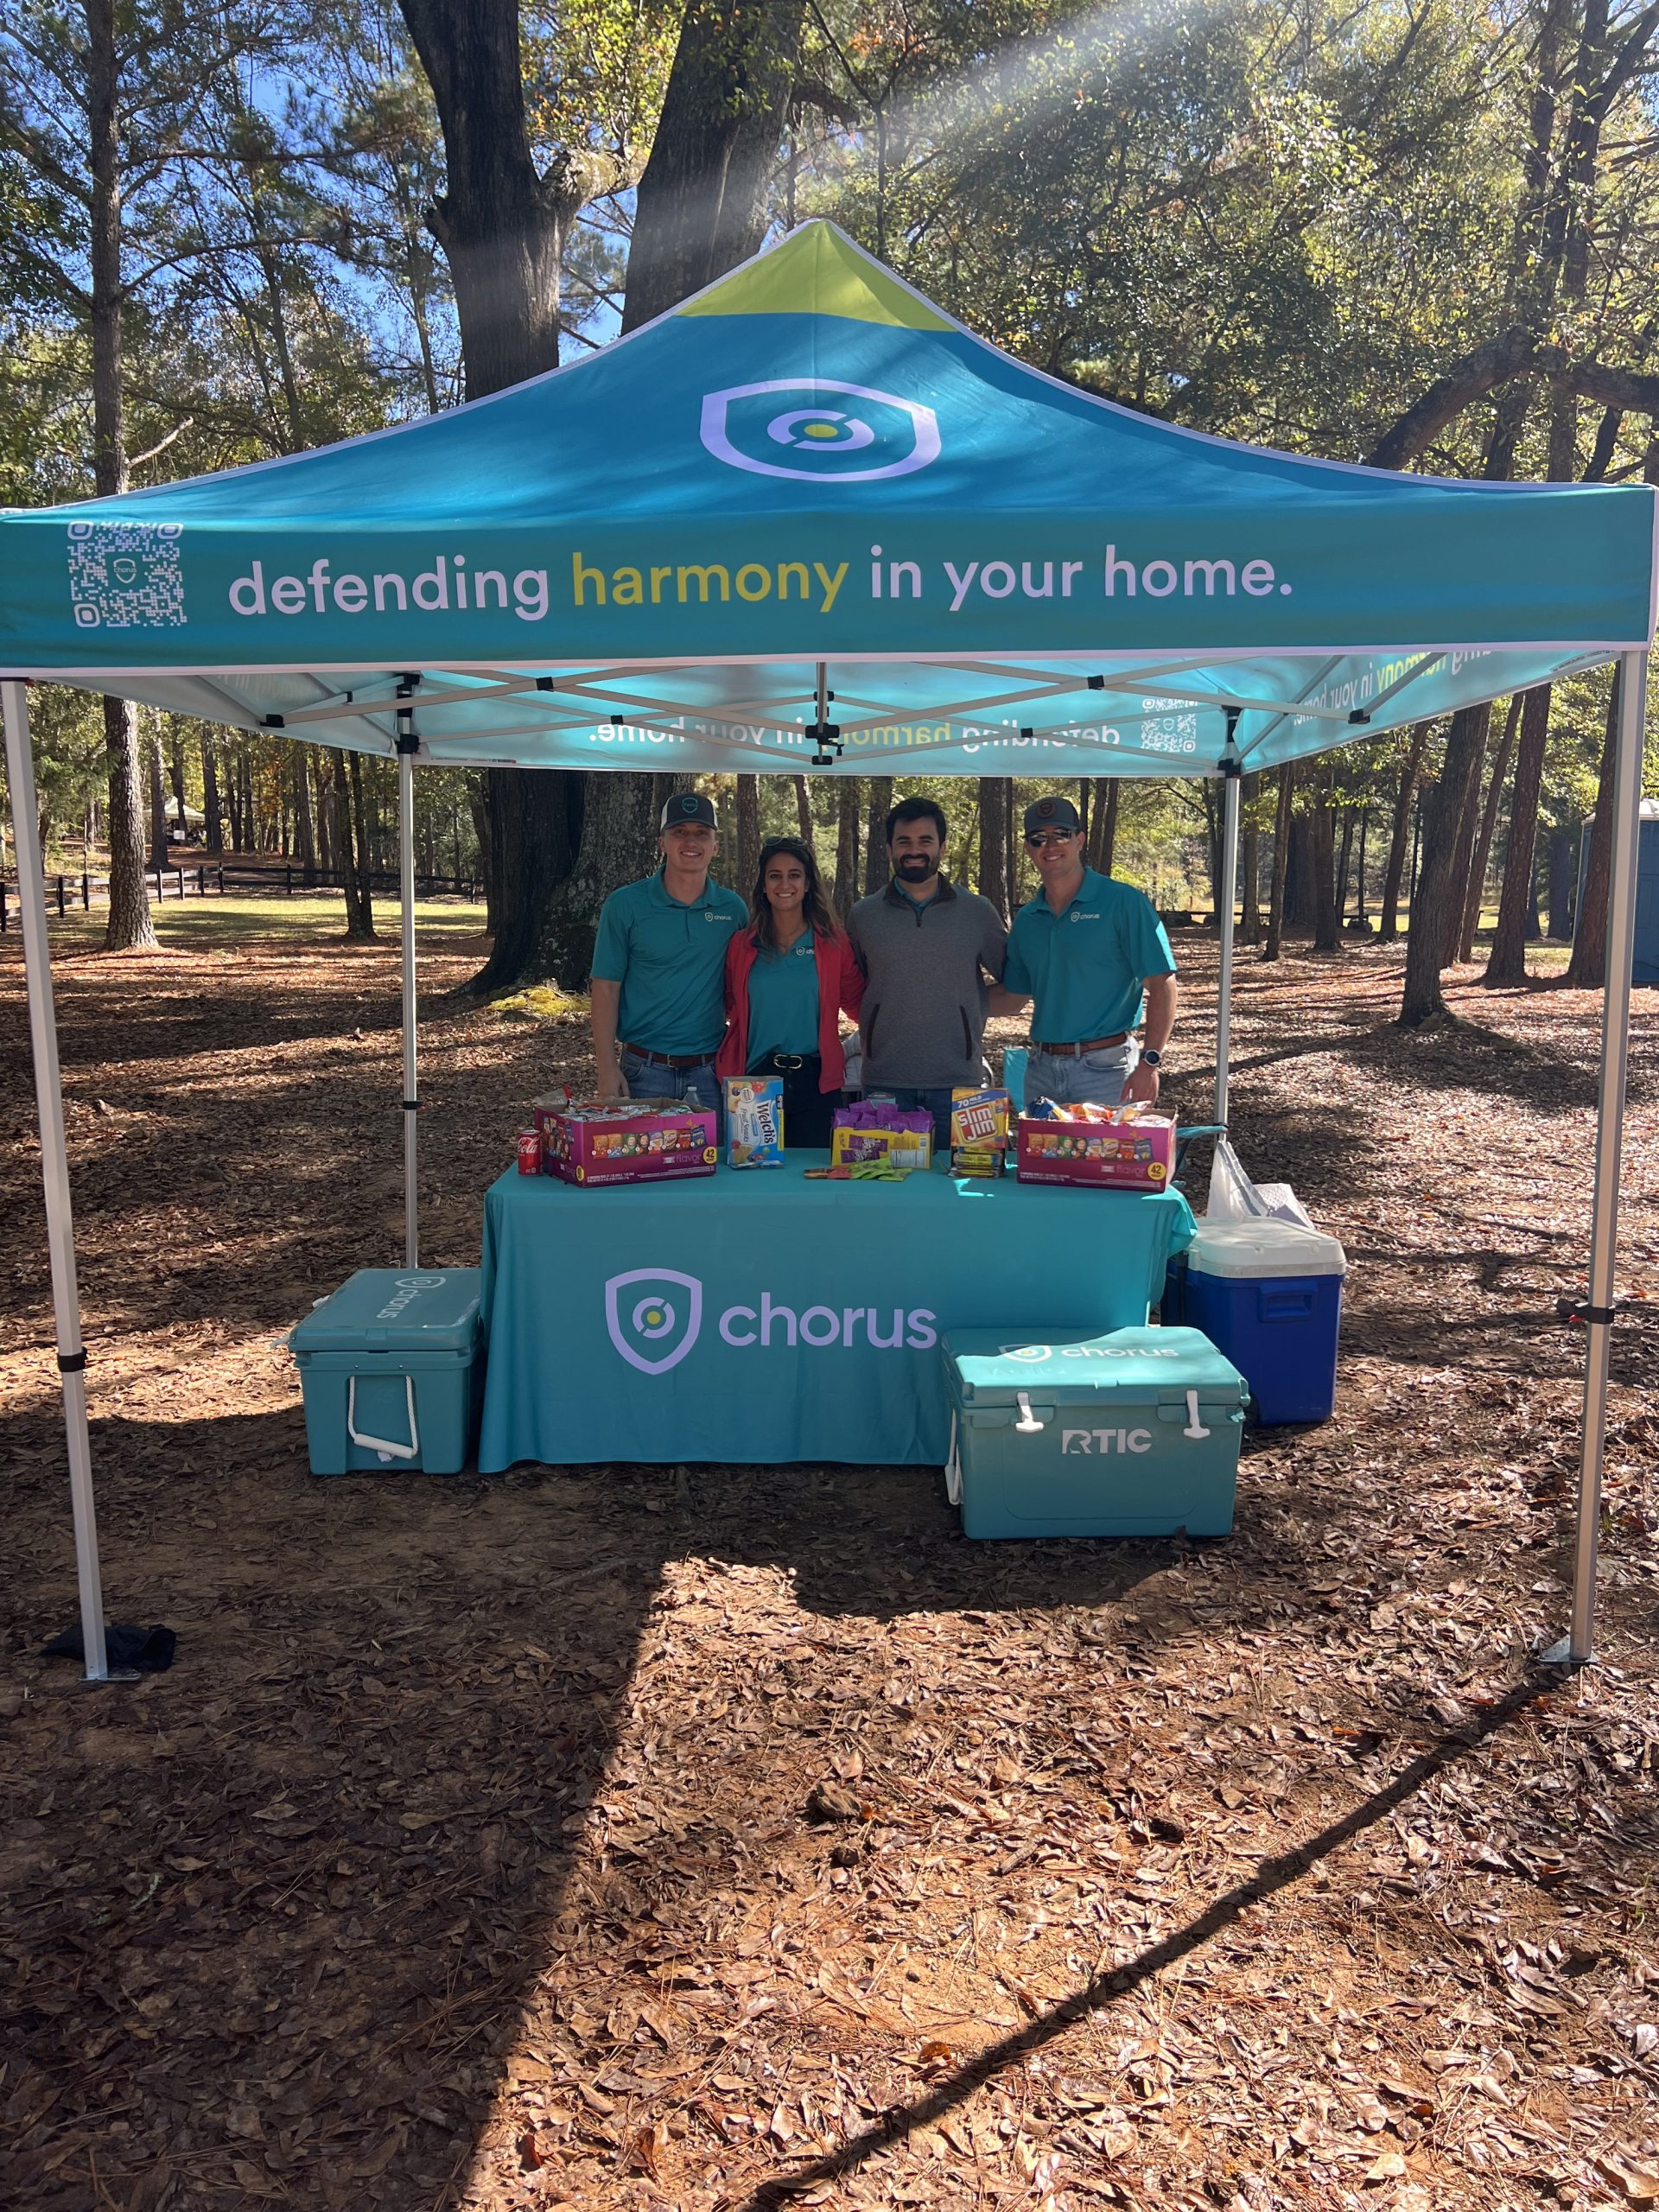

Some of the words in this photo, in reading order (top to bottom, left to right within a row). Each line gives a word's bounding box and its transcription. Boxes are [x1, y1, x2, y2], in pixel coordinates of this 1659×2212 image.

[228, 555, 549, 621] defending
[571, 551, 849, 613] harmony
[871, 544, 921, 598] in
[943, 560, 1083, 612] your
[1105, 544, 1293, 598] home.
[957, 1099, 969, 1109] 70
[757, 1102, 776, 1144] Welch's
[377, 1289, 422, 1319] chorus
[718, 1292, 938, 1350] chorus
[1061, 1346, 1179, 1357] chorus
[1061, 1428, 1153, 1454] RTIC
